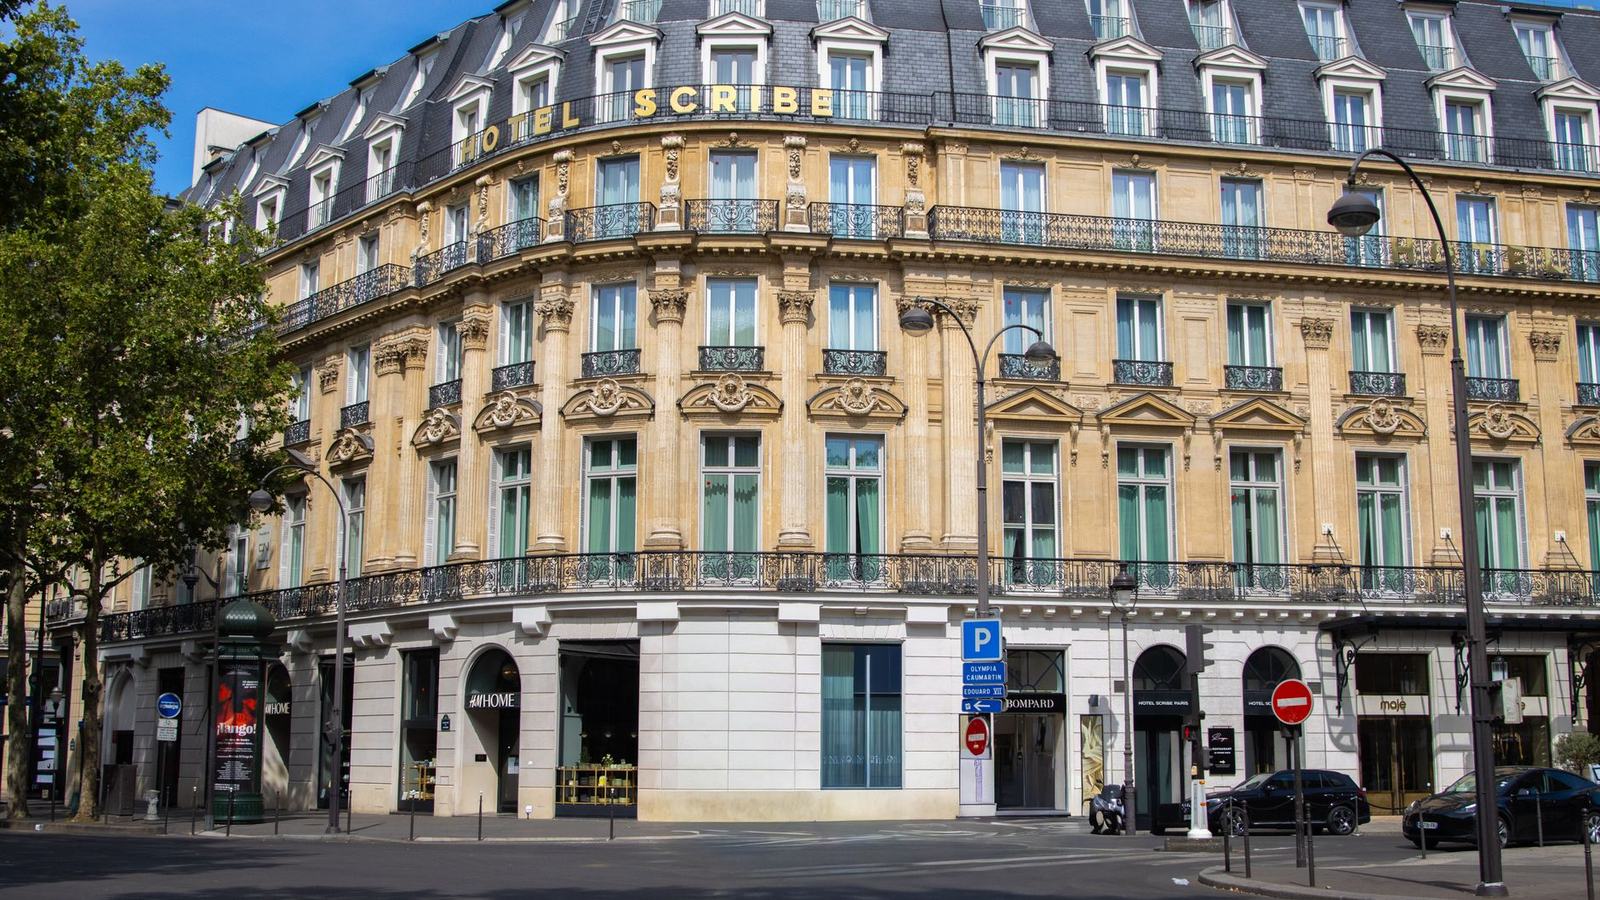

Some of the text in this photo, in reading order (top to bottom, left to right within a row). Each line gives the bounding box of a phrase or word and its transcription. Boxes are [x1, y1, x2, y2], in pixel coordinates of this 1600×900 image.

[461, 85, 833, 162] HOTEL SCRIBE
[975, 627, 991, 653] P
[992, 687, 1003, 695] VII
[483, 693, 515, 708] HOME
[1006, 699, 1054, 708] BOMPARD
[1380, 698, 1407, 712] maje
[271, 702, 290, 714] HOME
[216, 722, 257, 737] ¡Tango!
